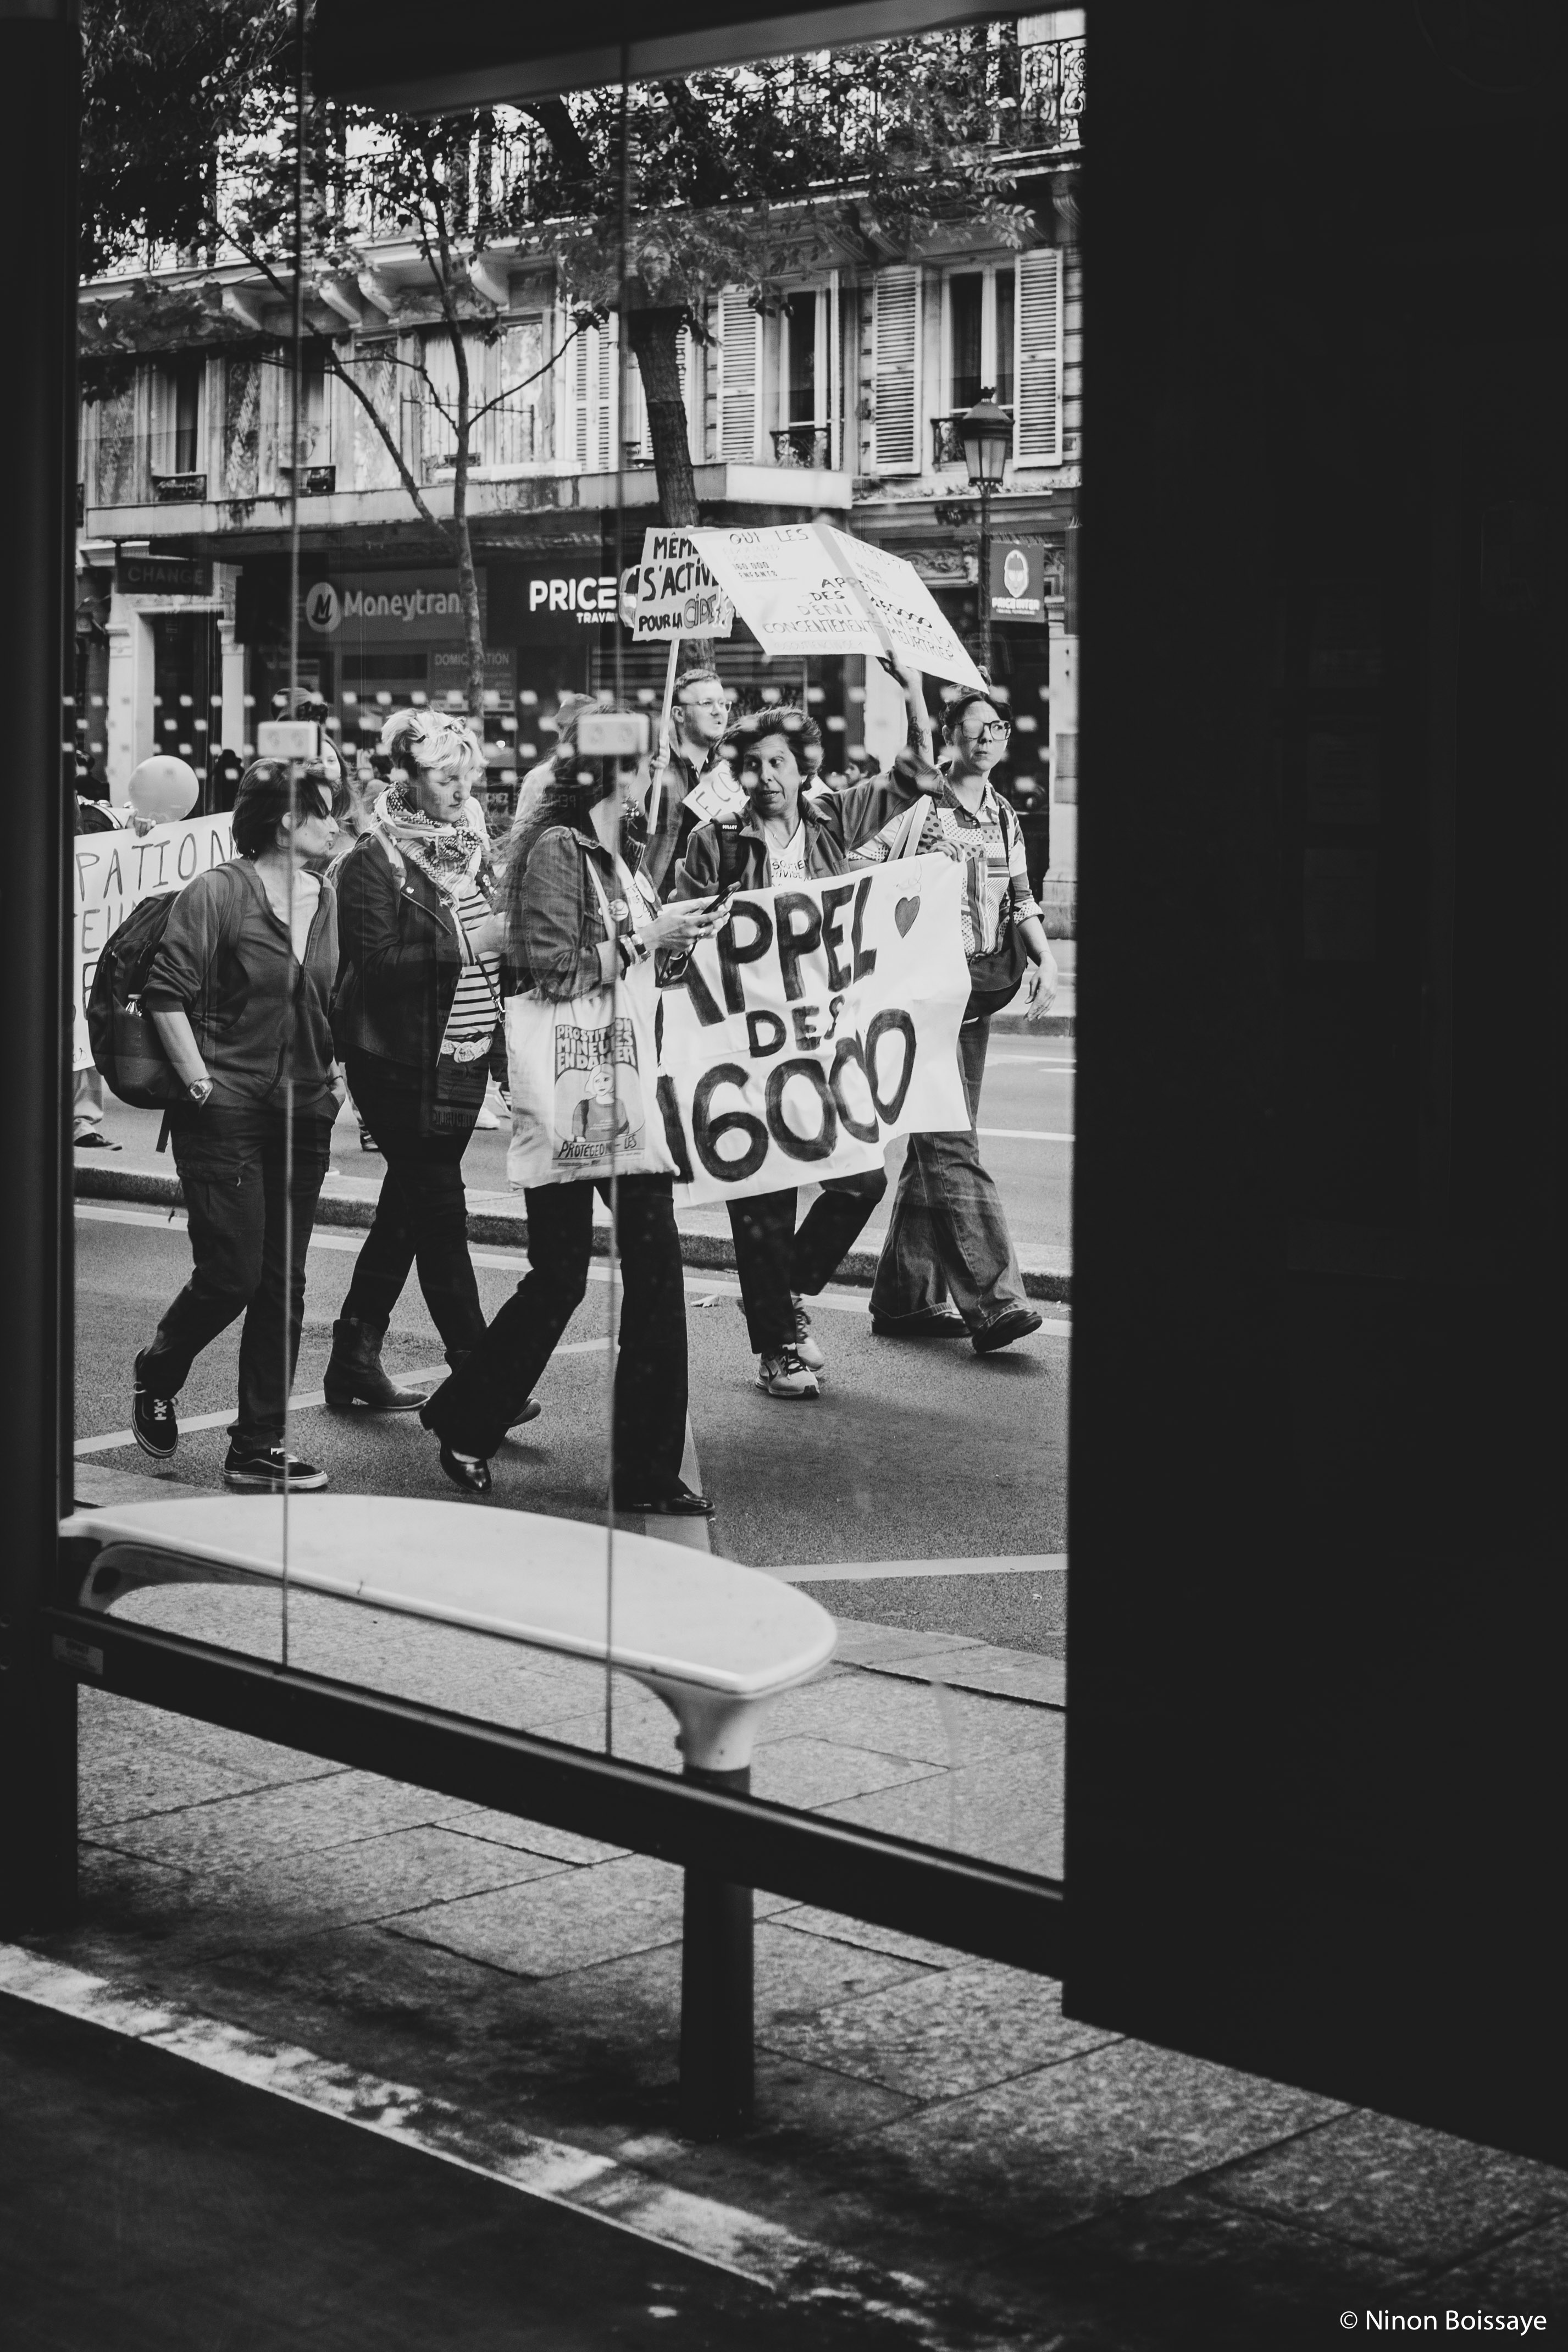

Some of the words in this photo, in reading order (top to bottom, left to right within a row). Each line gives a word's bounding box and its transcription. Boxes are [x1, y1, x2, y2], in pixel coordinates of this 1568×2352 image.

[774, 528, 809, 542] LES
[128, 566, 204, 585] CHANGE
[642, 557, 719, 601] S'ACTiV
[529, 577, 618, 612] PRICE
[810, 590, 845, 601] DES
[344, 589, 463, 622] Moneytran
[797, 602, 852, 616] DÉNI
[639, 613, 671, 632] POUR
[672, 612, 683, 629] LA
[762, 619, 876, 634] CONSENTEMENT
[434, 653, 509, 666] DOMICTION
[557, 1019, 632, 1042] PROSTITON
[557, 1031, 633, 1056] MINEUES
[557, 1053, 575, 1075] EN
[577, 1046, 636, 1070] DANER
[656, 1008, 917, 1183] 16000
[558, 1140, 614, 1158] PROTÉGEO
